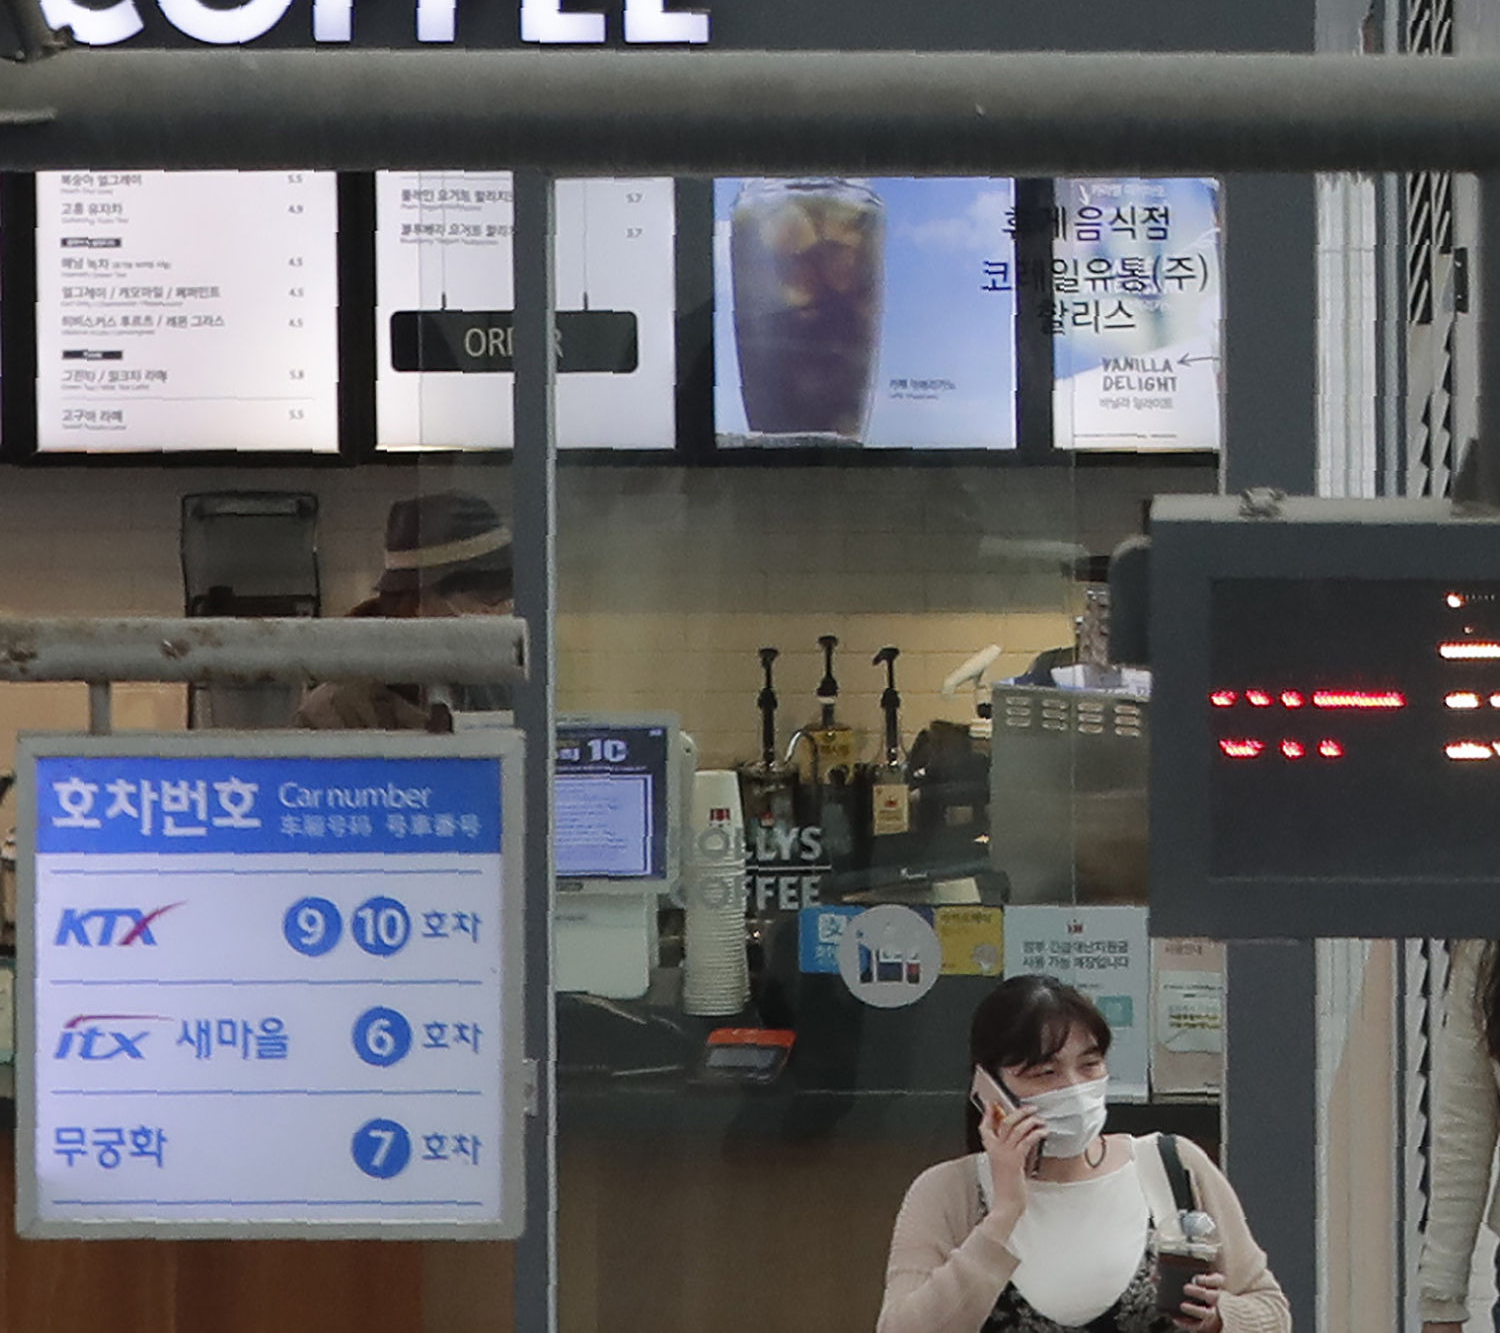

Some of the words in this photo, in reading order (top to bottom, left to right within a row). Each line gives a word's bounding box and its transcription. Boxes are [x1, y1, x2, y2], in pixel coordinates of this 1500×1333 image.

[1102, 357, 1174, 373] VANILLA
[1102, 376, 1178, 392] DELIGHT
[51, 776, 261, 837] 호차번호
[278, 781, 322, 809] Car
[326, 782, 433, 810] number
[55, 905, 172, 947] KTX
[421, 910, 483, 944] 호차
[54, 1016, 152, 1061] itx
[177, 1016, 291, 1061] 새마을
[422, 1020, 483, 1054] 호차
[54, 1124, 168, 1170] 무궁화
[421, 1131, 483, 1166] 호차
